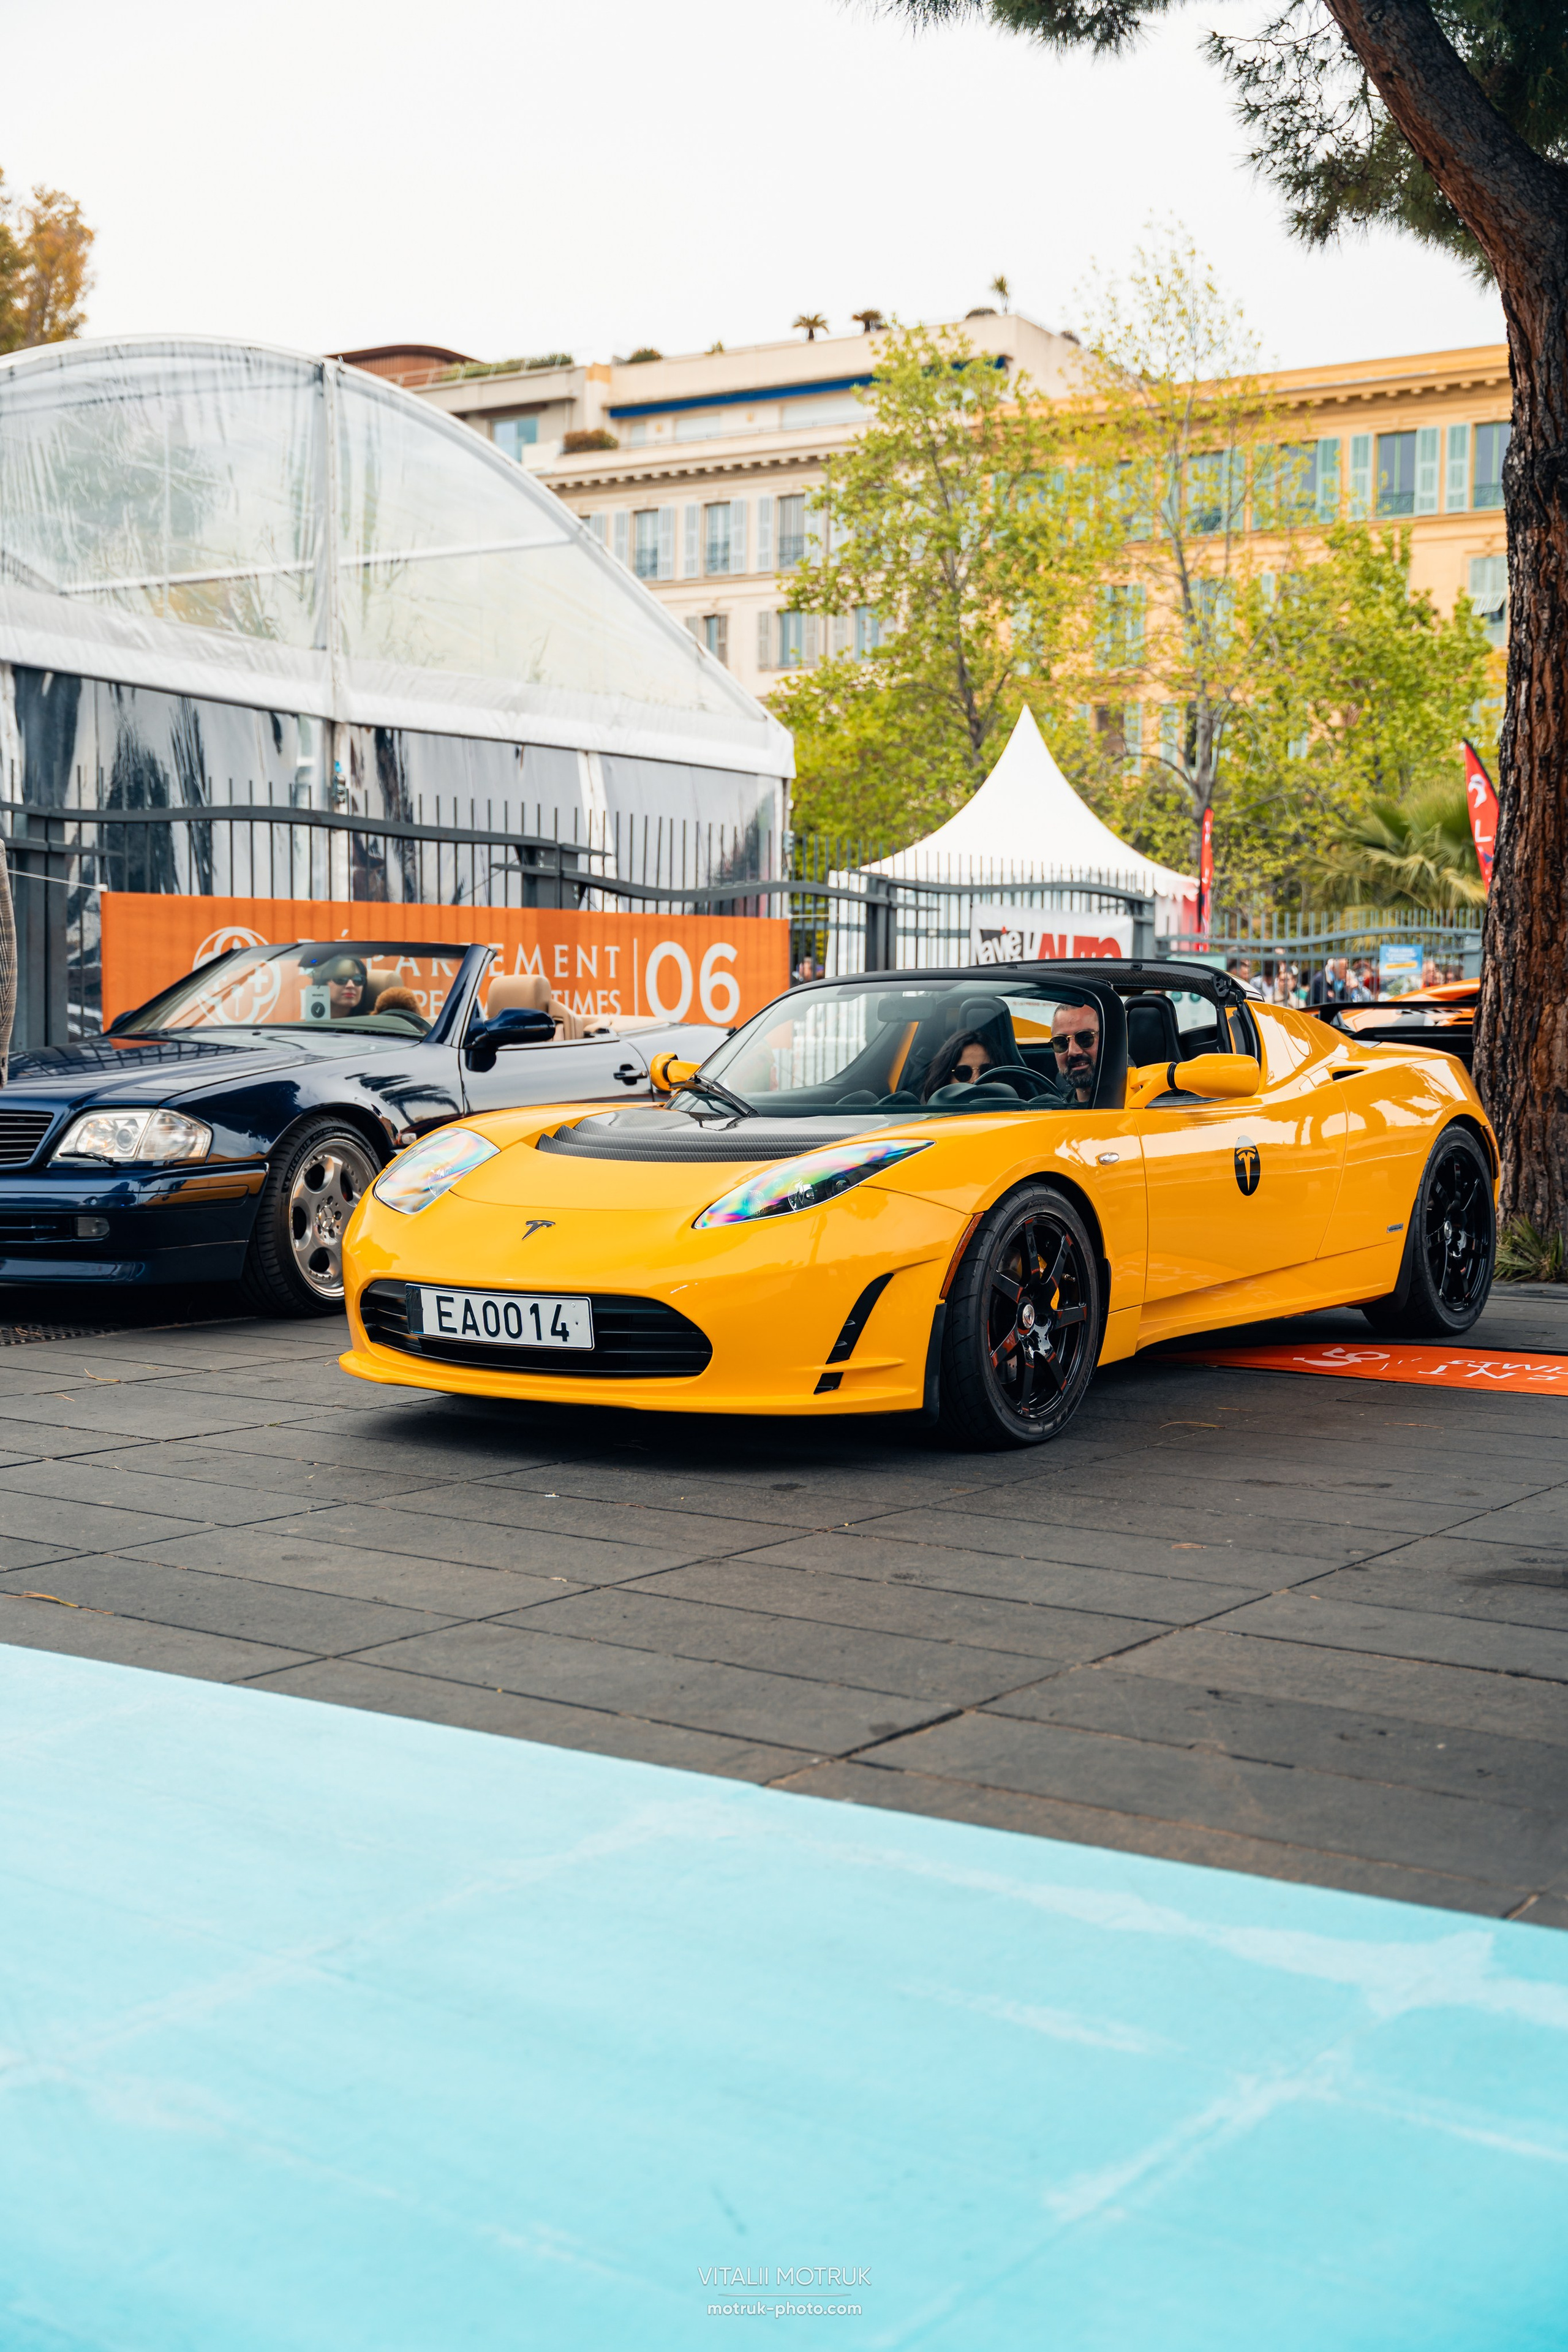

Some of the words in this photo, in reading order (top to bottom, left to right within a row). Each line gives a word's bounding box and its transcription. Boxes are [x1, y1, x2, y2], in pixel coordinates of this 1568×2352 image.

[645, 940, 741, 1024] 06
[287, 1139, 312, 1179] MICHELIN
[435, 1295, 570, 1342] EA0014
